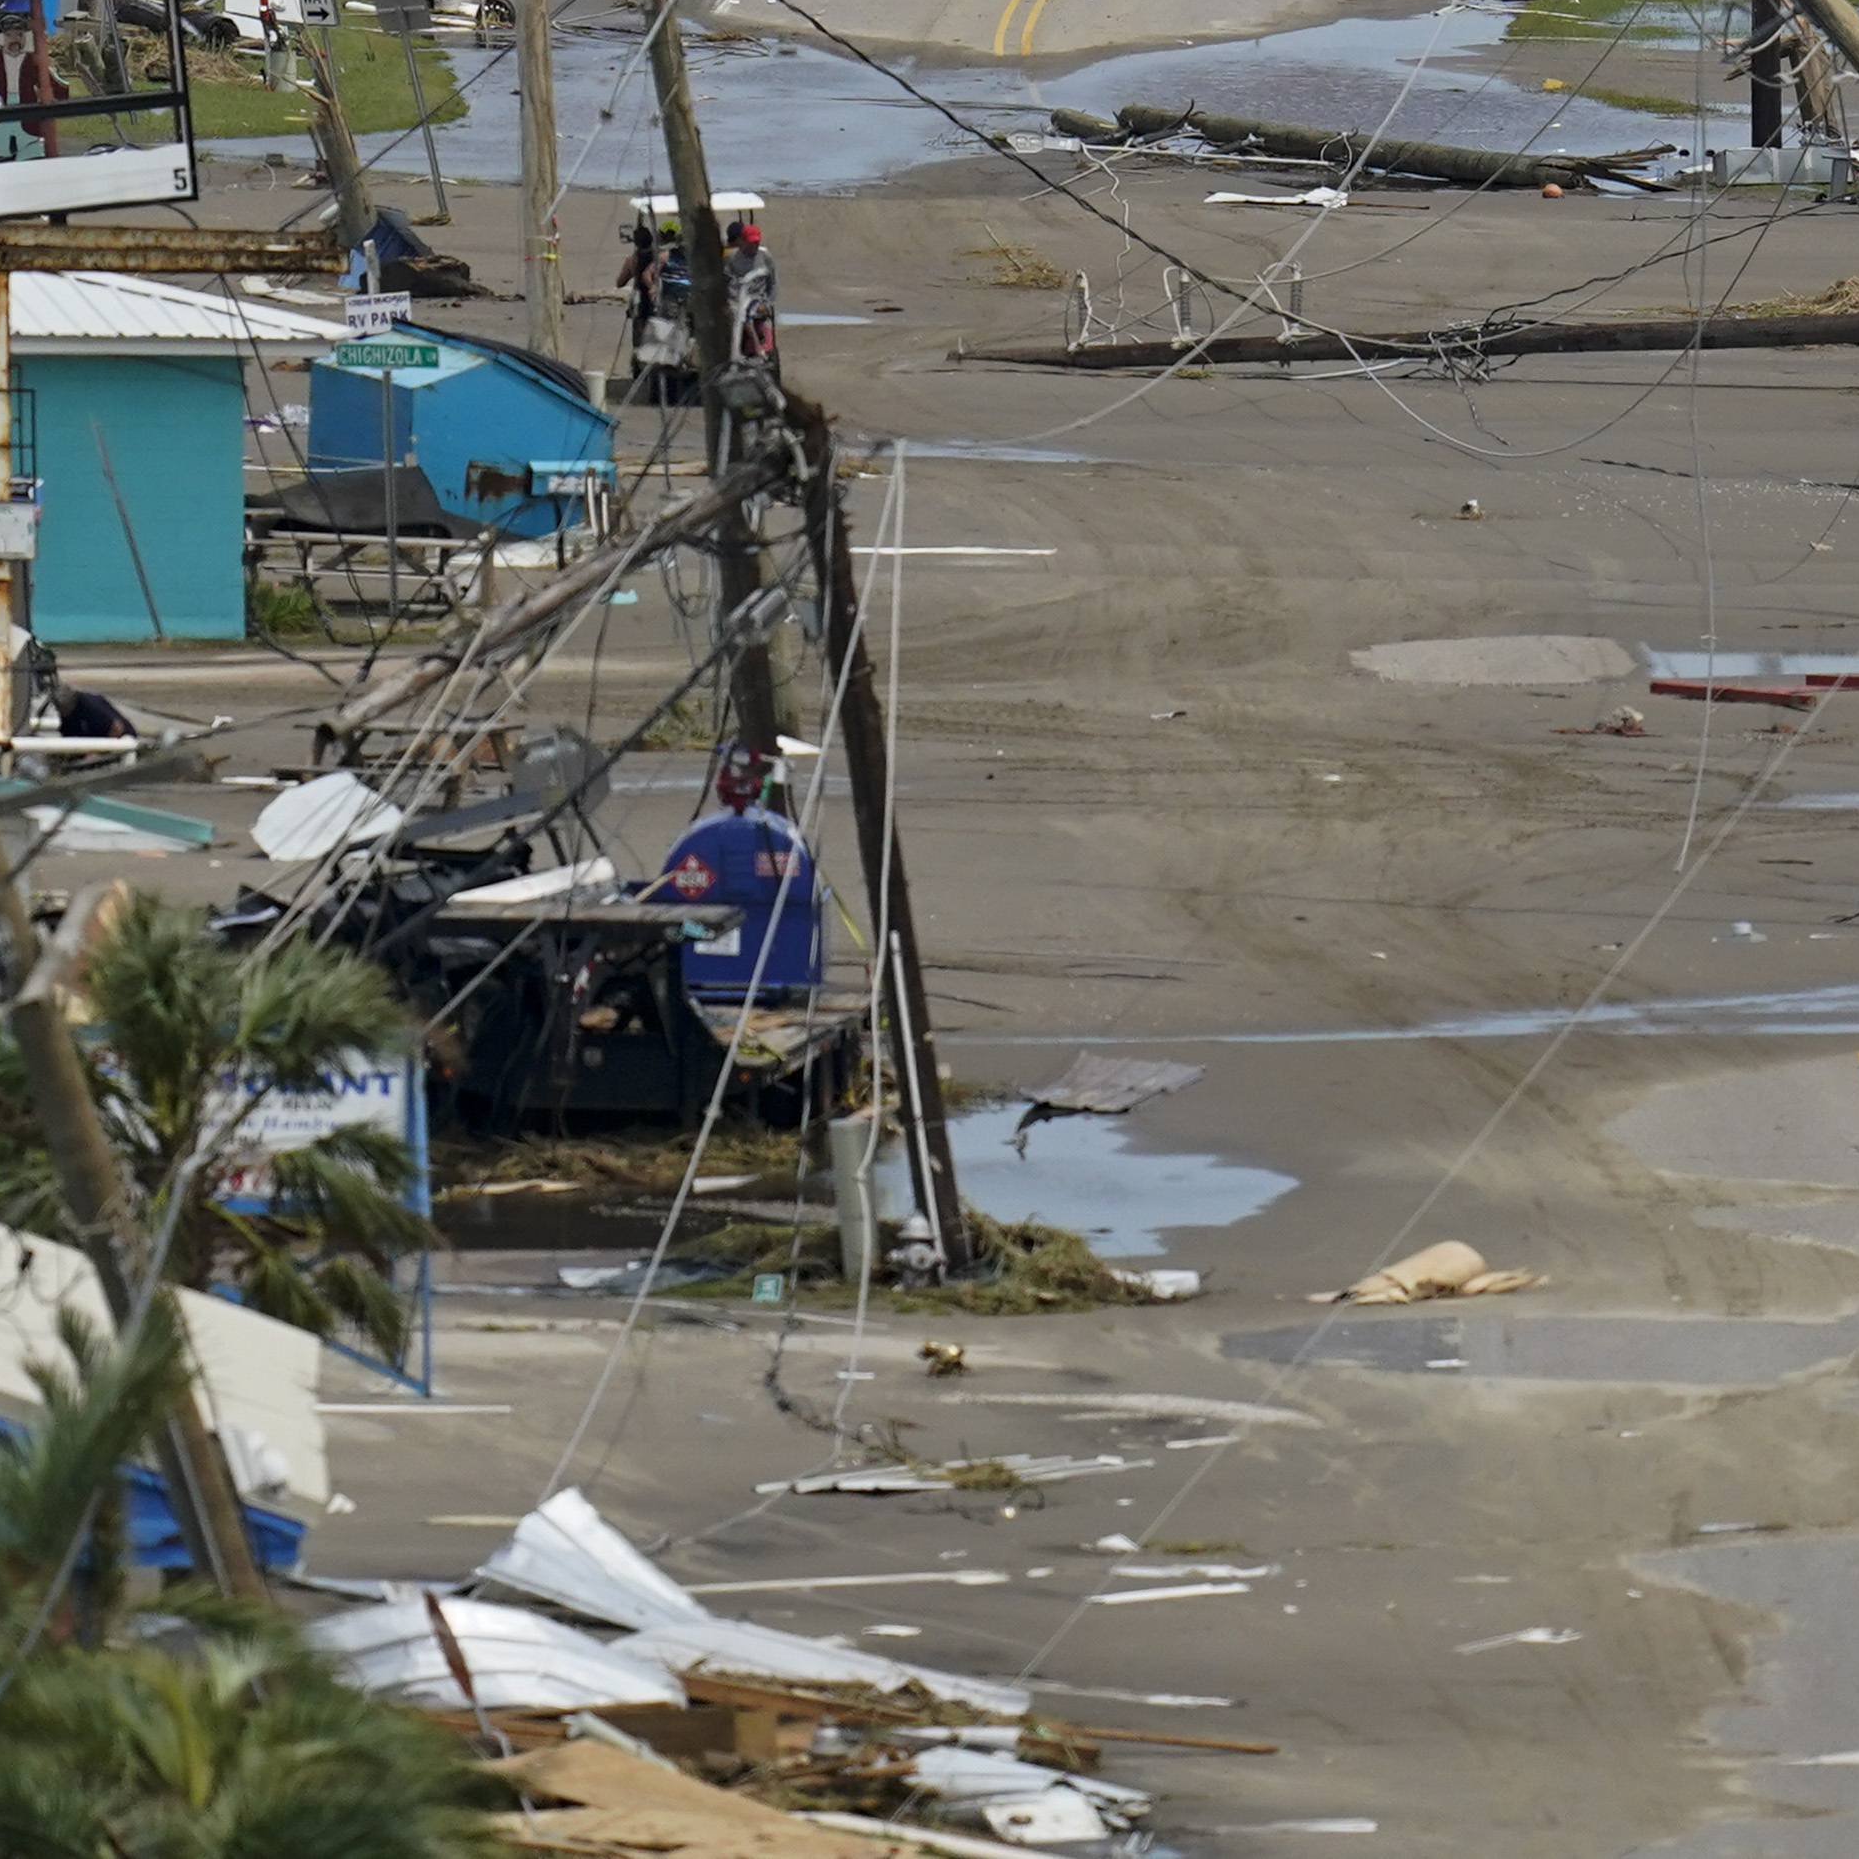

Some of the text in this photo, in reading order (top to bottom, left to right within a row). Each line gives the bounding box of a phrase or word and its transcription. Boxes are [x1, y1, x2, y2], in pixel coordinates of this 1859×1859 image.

[173, 168, 188, 191] 5
[347, 309, 409, 328] RV PARK
